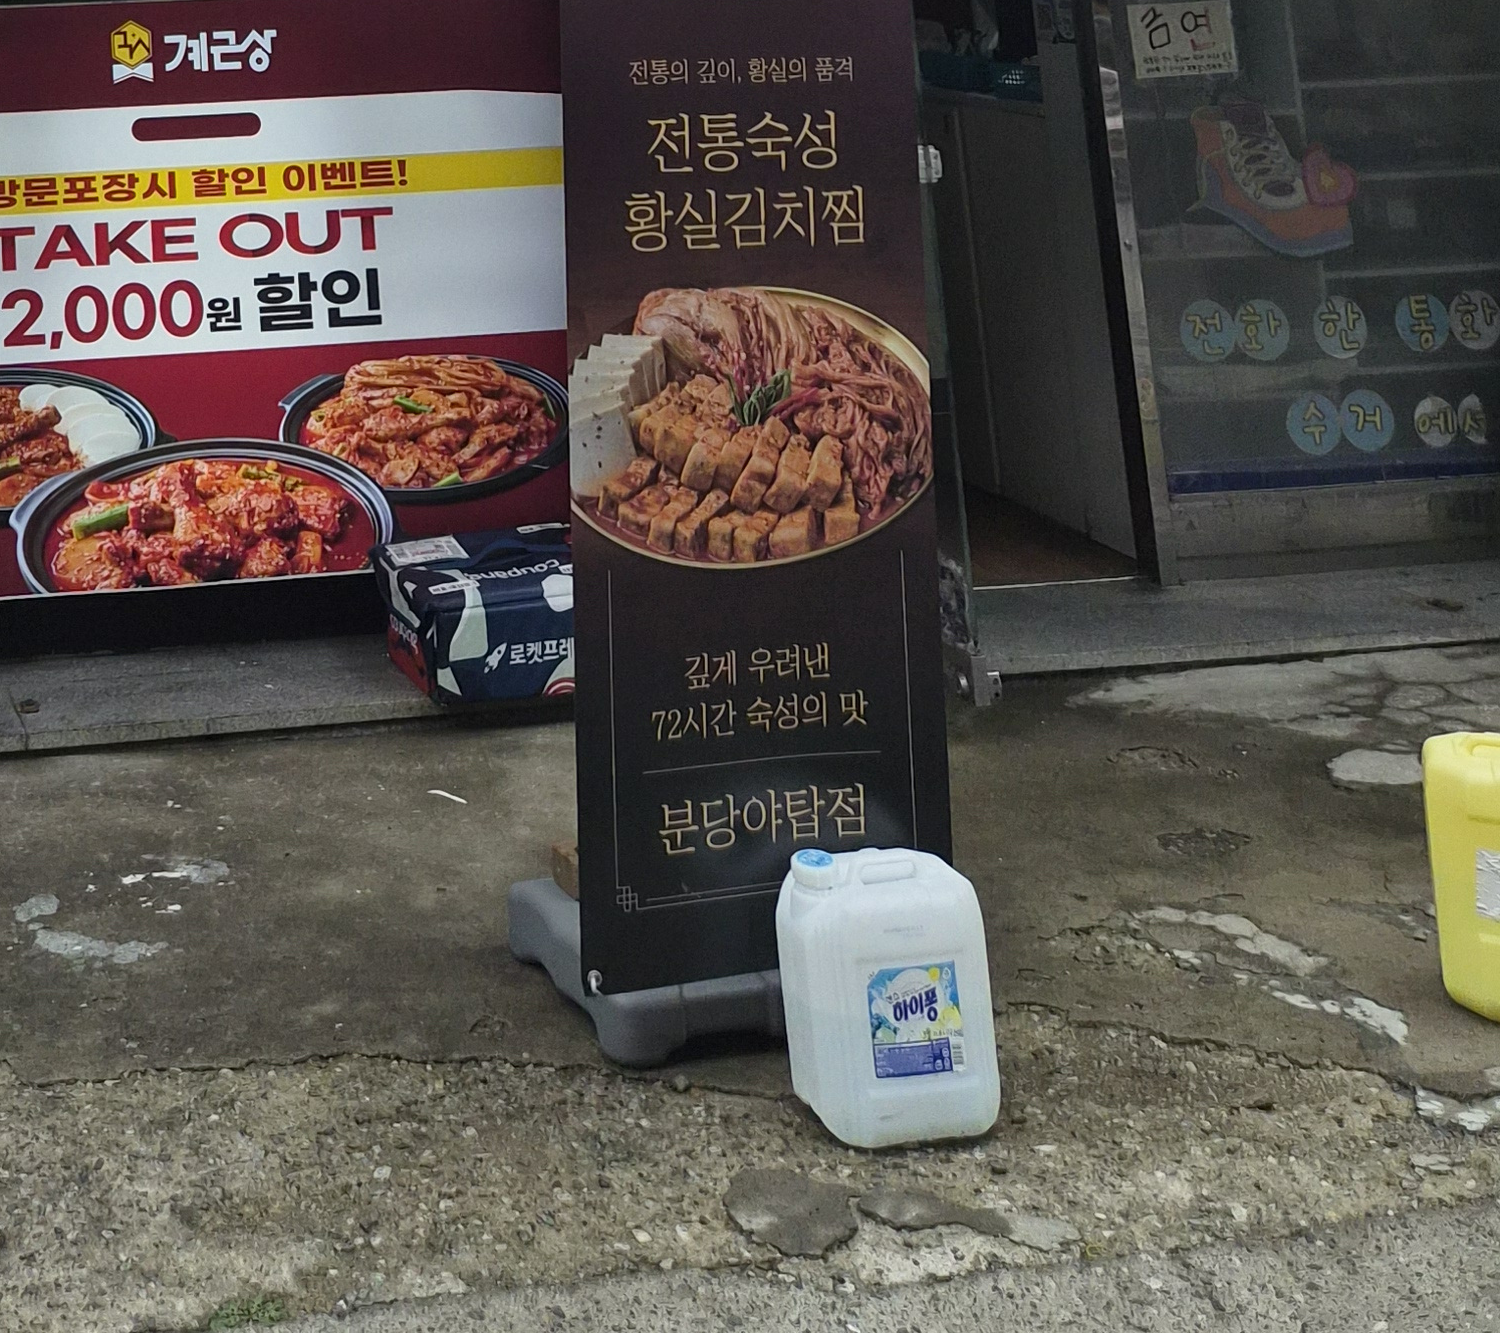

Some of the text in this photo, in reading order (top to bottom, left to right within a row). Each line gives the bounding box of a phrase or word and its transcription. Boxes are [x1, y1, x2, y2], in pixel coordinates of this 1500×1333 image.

[163, 28, 277, 74] 계근상
[628, 56, 854, 85] 전통의 깊이, 황실의 품격
[647, 109, 839, 174] 전통숙성
[191, 165, 268, 198] 할인
[281, 158, 409, 194] 이벤트!
[217, 206, 394, 259] OUT
[624, 184, 866, 252] 황실김치찜
[251, 266, 384, 333] 할인
[684, 642, 831, 690] 깊게 우려낸
[651, 689, 869, 741] 72시간 숙성의 맛
[658, 782, 867, 856] 분당야탑점
